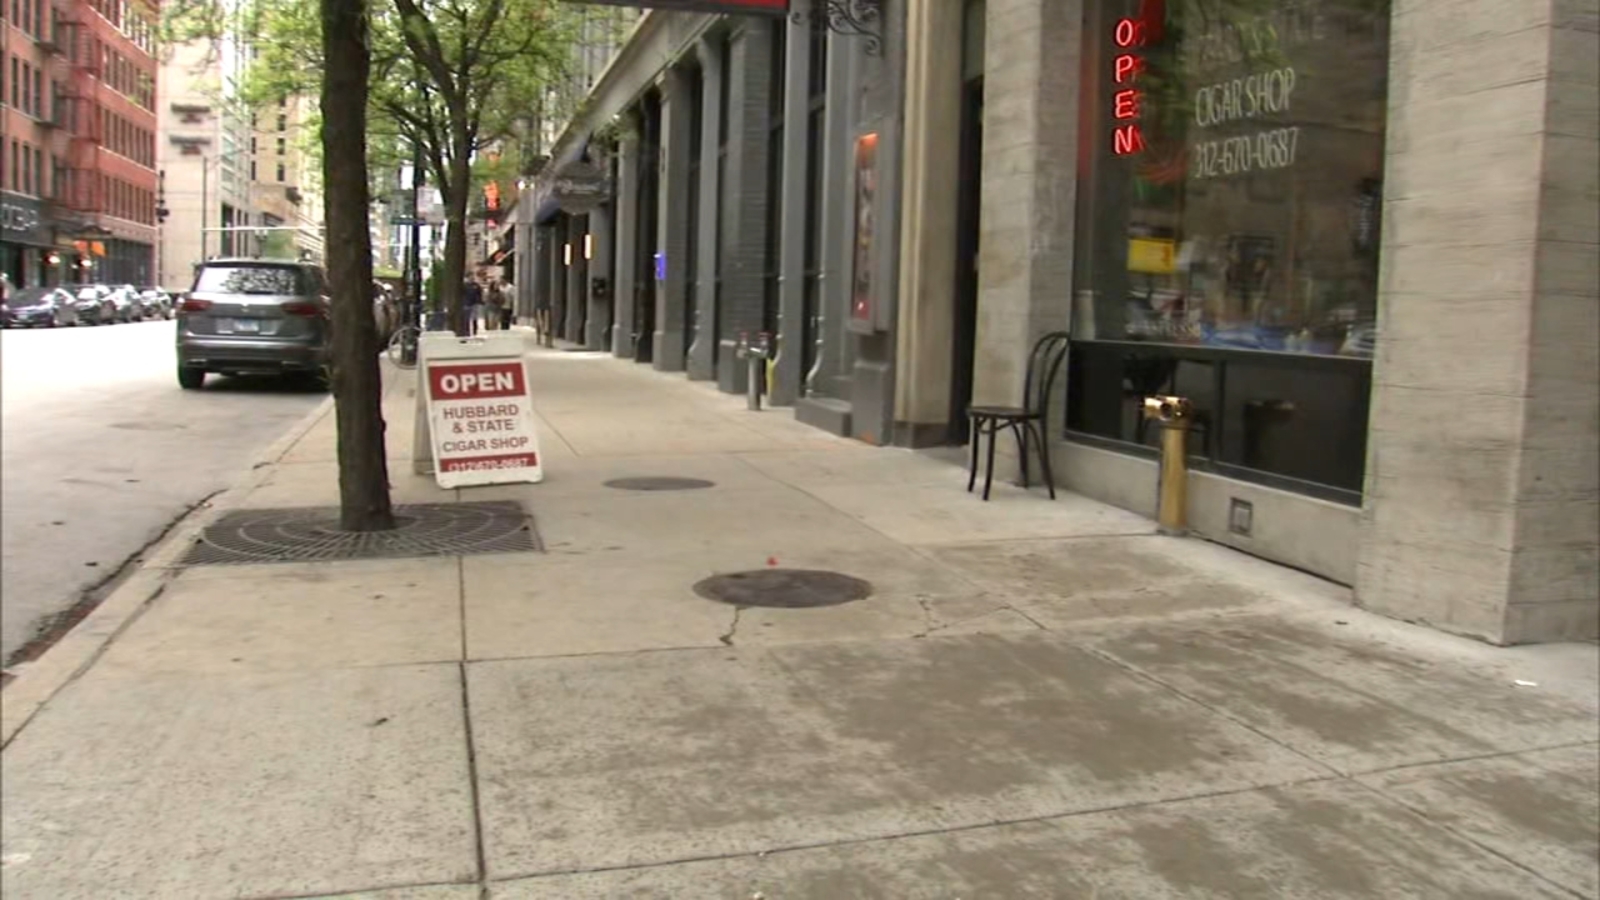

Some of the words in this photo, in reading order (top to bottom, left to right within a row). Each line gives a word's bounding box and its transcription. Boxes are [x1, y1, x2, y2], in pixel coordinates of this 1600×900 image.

[1113, 18, 1135, 154] OPEN
[1194, 79, 1242, 127] CIGAR
[1245, 67, 1296, 118] SHOP
[440, 371, 514, 393] OPEN
[443, 404, 519, 420] HUBBARD
[452, 422, 463, 434] &
[467, 419, 515, 433] STATE
[442, 440, 487, 452] CIGAR
[490, 436, 529, 449] SHOP
